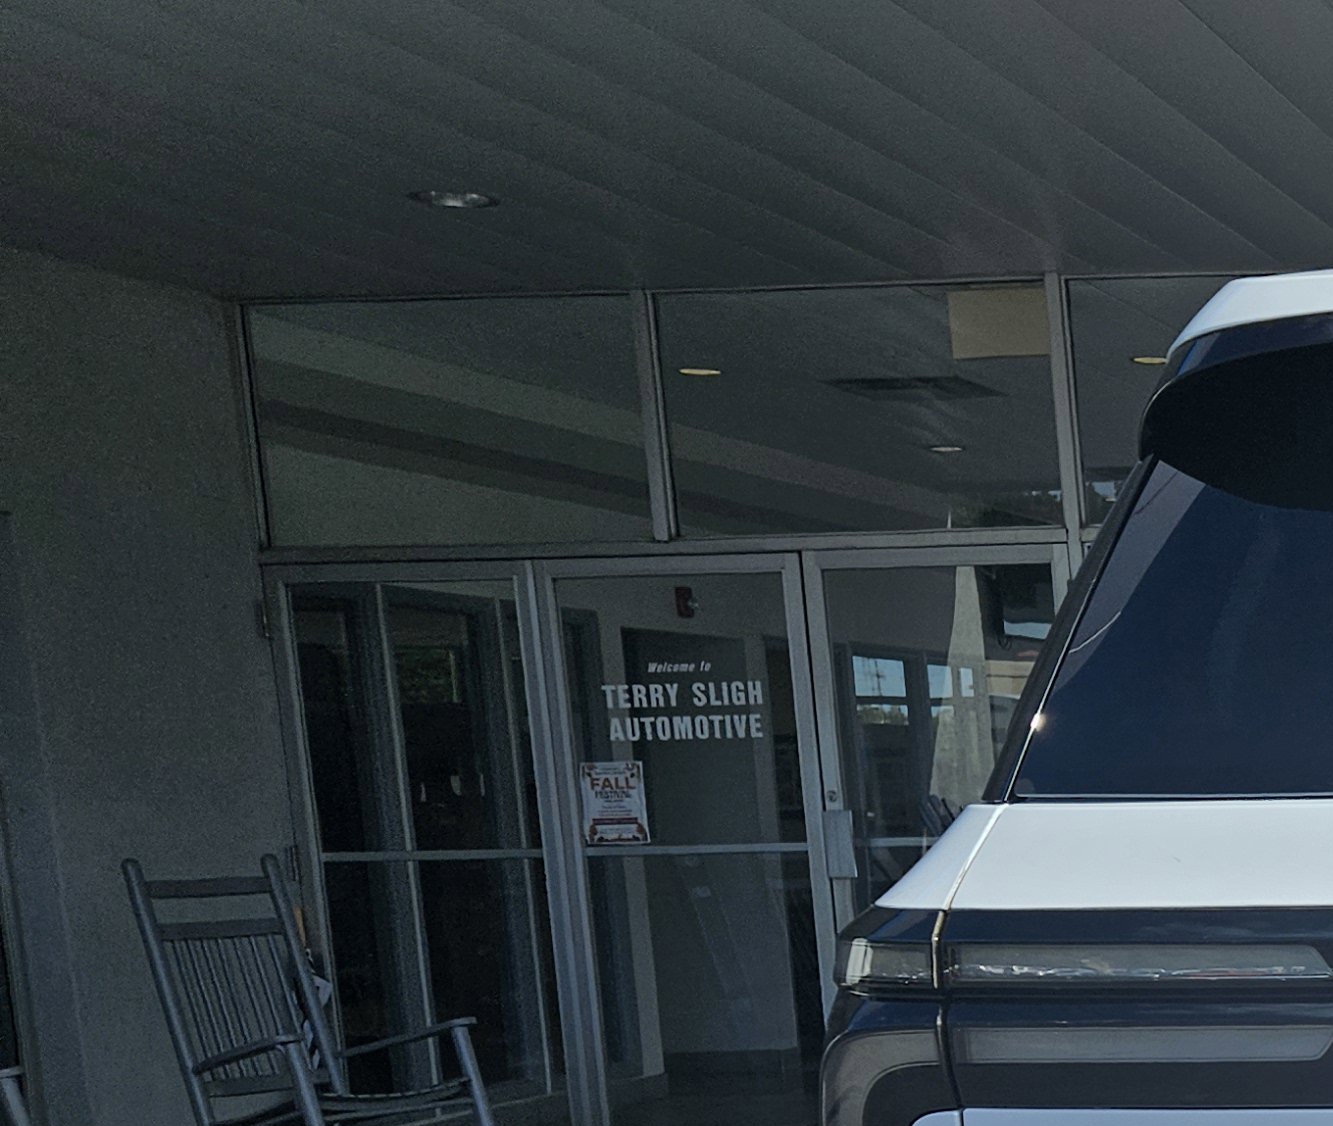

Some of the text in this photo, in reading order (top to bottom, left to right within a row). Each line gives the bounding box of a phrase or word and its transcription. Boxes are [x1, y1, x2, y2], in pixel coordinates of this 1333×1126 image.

[648, 661, 711, 673] Welcome to
[601, 680, 763, 709] TERRY SLIGH
[609, 714, 763, 742] AUTOMOTIVE
[590, 777, 636, 790] FALL
